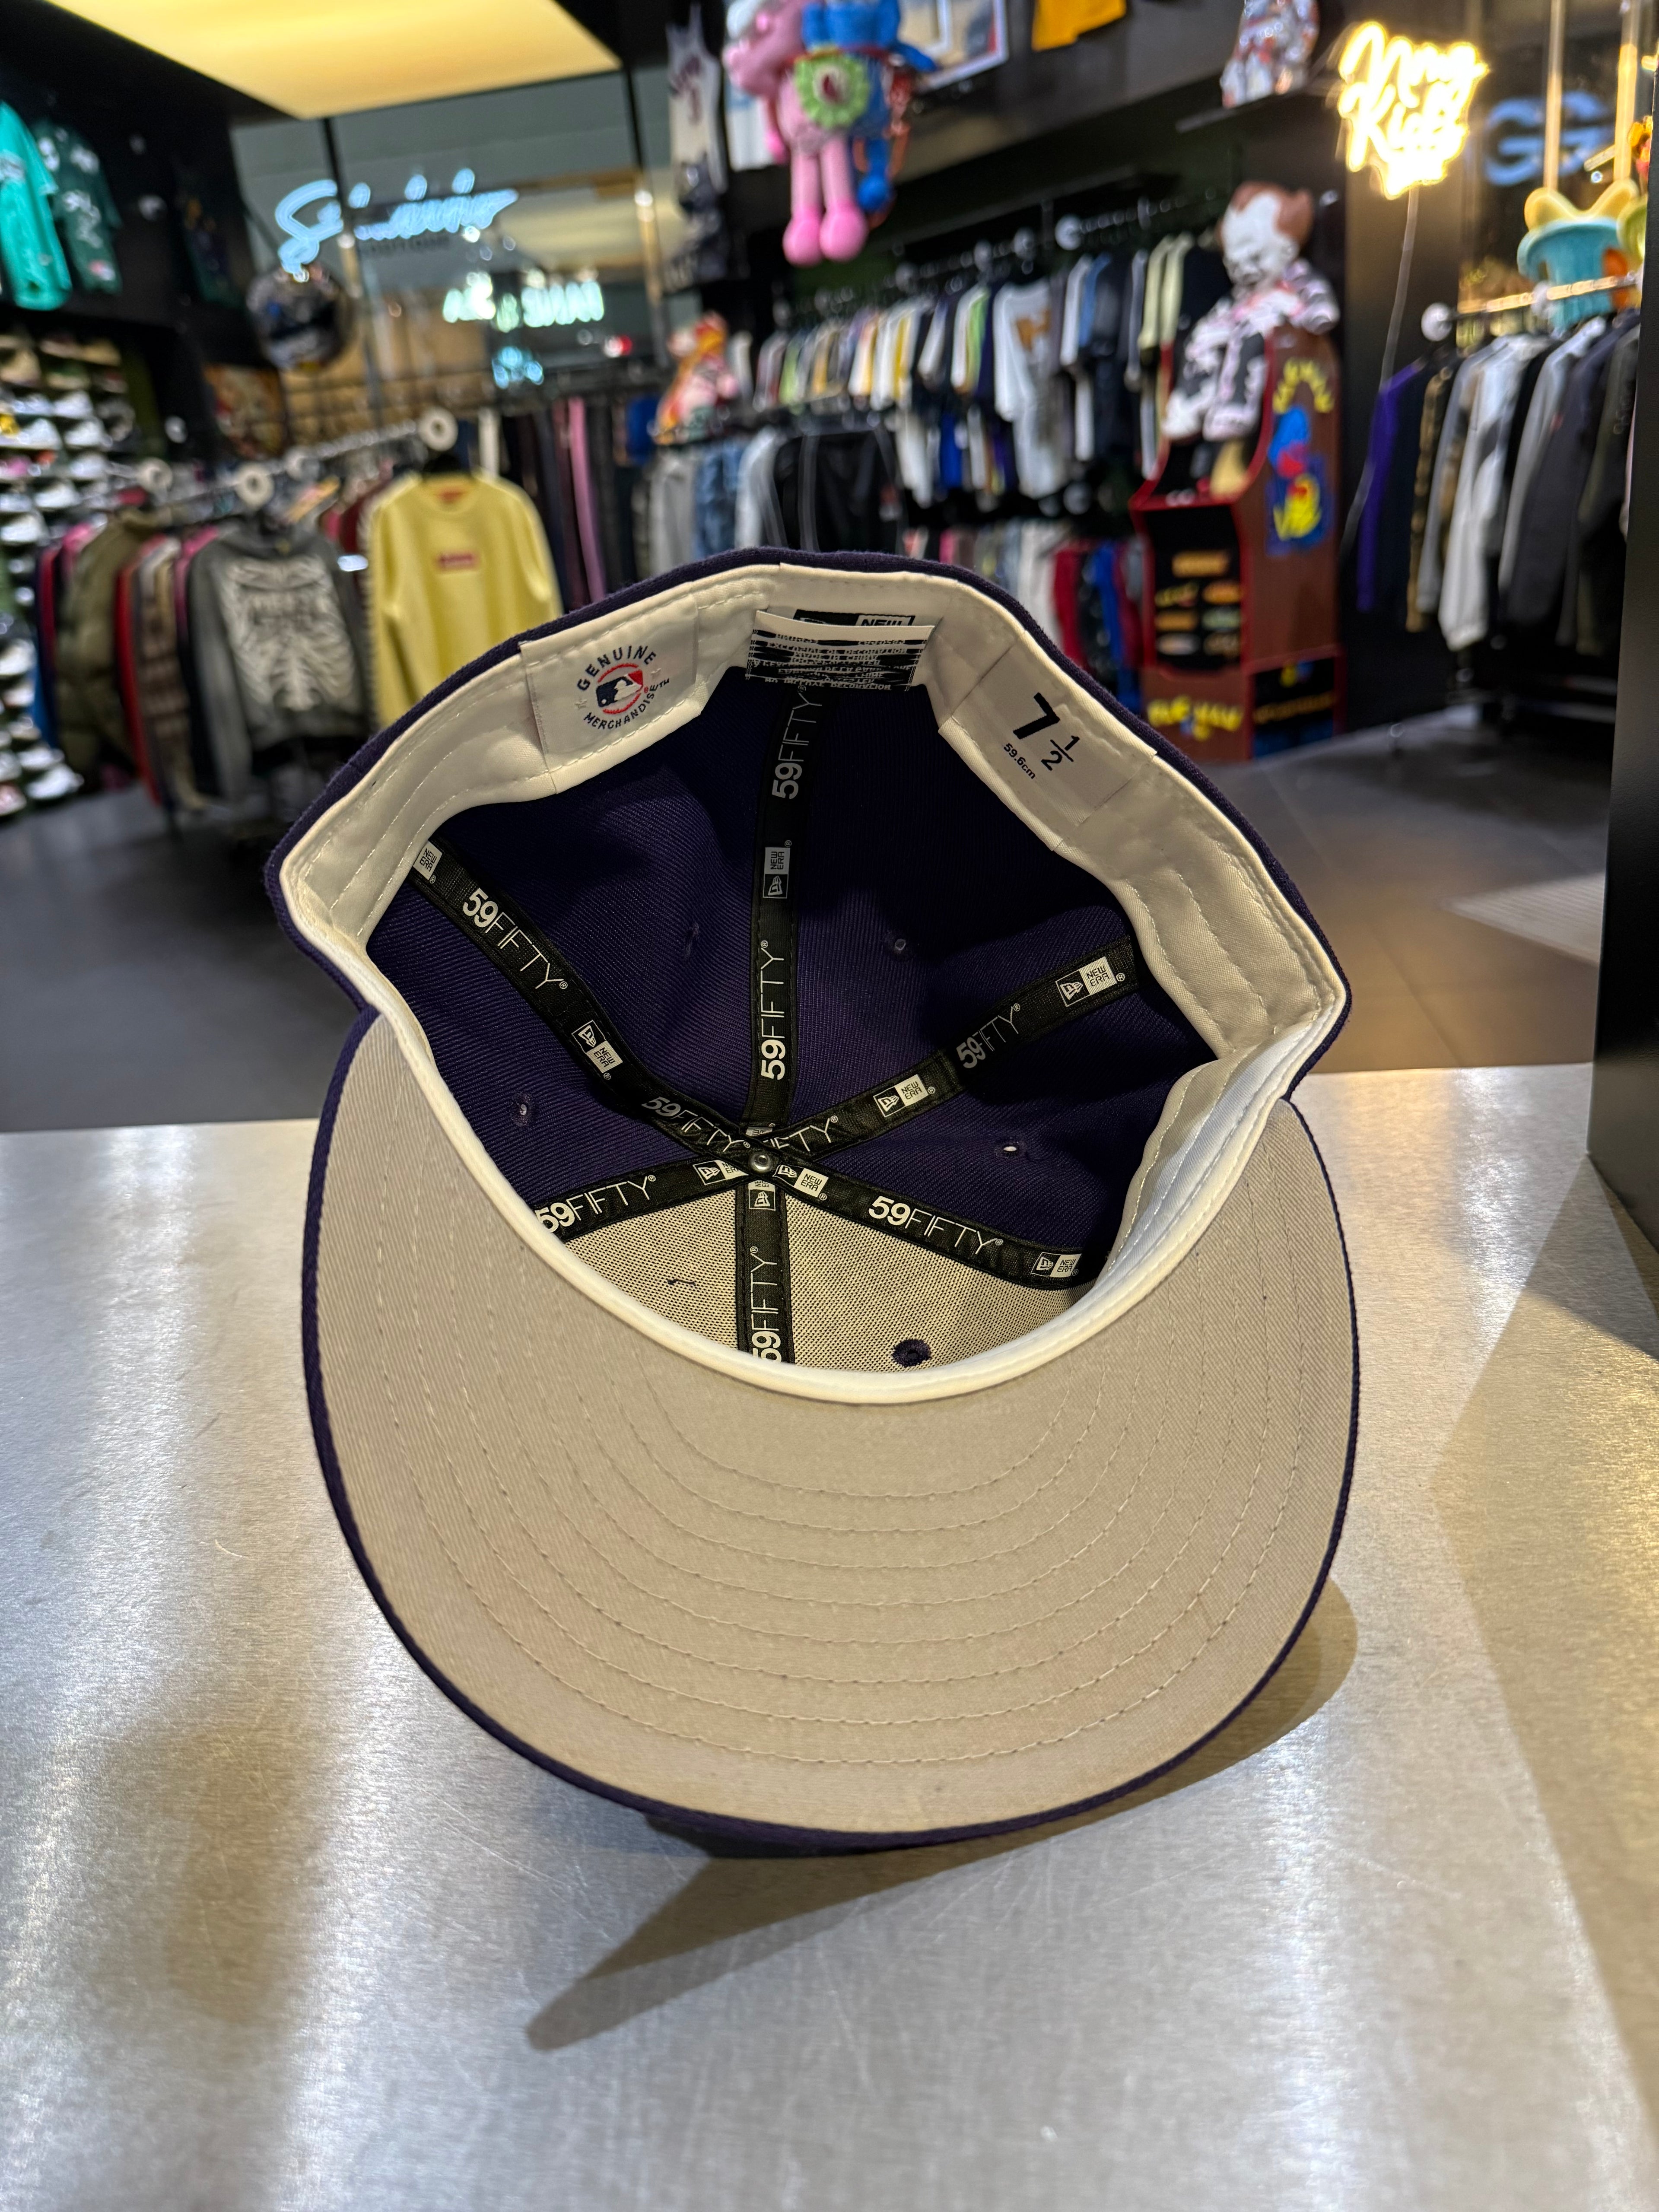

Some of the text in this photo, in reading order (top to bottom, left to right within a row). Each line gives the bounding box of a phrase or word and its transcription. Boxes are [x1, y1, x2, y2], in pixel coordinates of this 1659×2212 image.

[577, 645, 656, 691] GENUINE
[1004, 743, 1036, 779] 59.6cm
[423, 848, 437, 864] NEW
[420, 856, 433, 872] ERA
[1087, 965, 1106, 979] NEW
[1090, 973, 1109, 986] ERA
[594, 1051, 609, 1067] ERA
[599, 1047, 615, 1064] NEW
[901, 1081, 918, 1093] NEW
[905, 1087, 922, 1100] ERA
[801, 1179, 818, 1191] ERA
[804, 1173, 822, 1185] NEW
